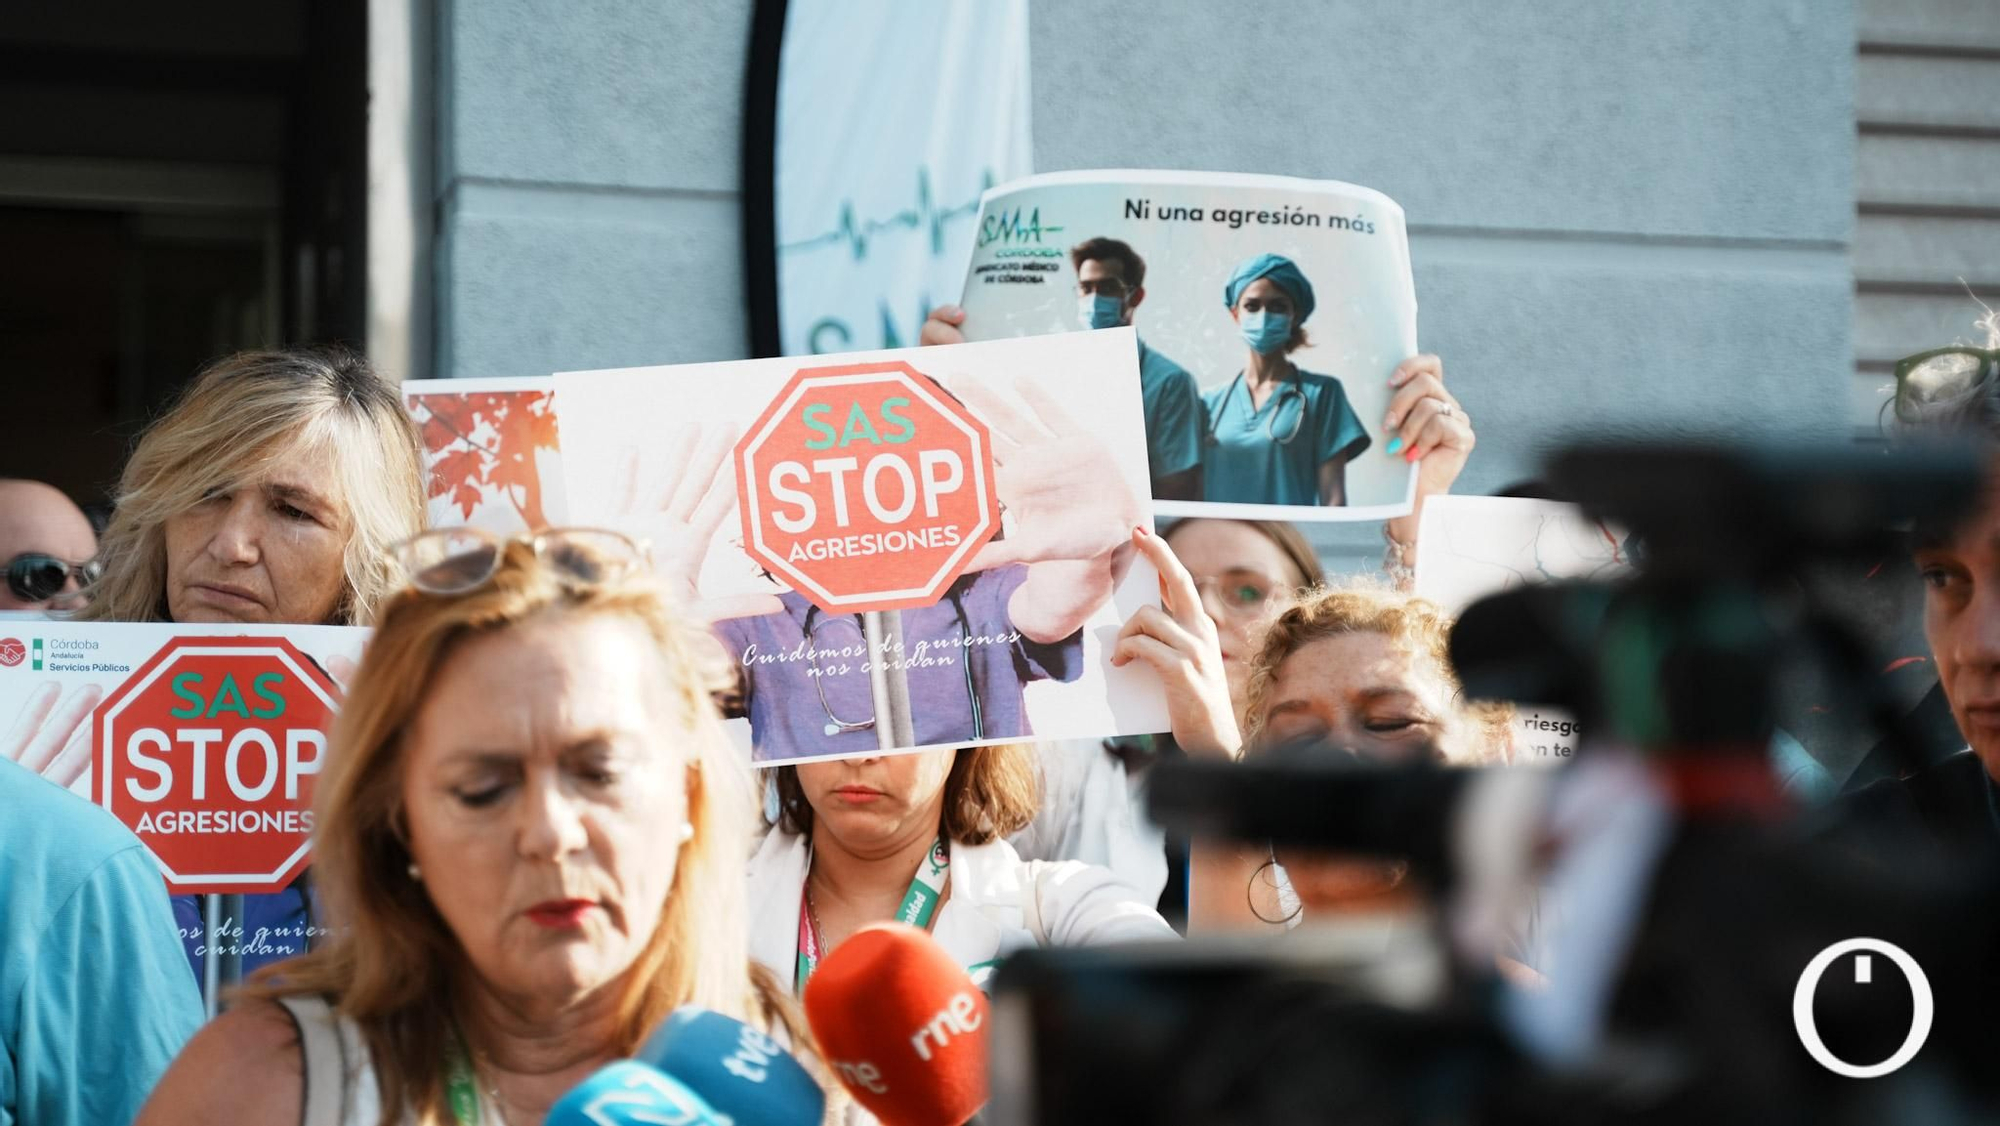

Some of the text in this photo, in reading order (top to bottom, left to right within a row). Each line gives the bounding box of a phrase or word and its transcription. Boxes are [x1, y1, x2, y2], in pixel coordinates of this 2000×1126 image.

[1124, 199, 1376, 235] Ni una agresión más
[802, 397, 915, 449] SAS
[768, 449, 963, 534] STOP
[788, 525, 961, 563] AGRESIONES
[50, 639, 99, 650] Córdoba
[742, 642, 866, 667] Cuidemos
[876, 633, 905, 653] de
[49, 663, 130, 672] Servicios Públicos
[806, 663, 851, 678] nos
[171, 672, 286, 719] SAS
[125, 727, 328, 803] STOP
[1553, 743, 1571, 757] te
[135, 810, 315, 834] AGRESIONES
[213, 917, 244, 938] de
[194, 938, 294, 956] cuidan
[911, 992, 982, 1062] rne
[721, 1024, 781, 1084] tve
[830, 1060, 888, 1094] ne
